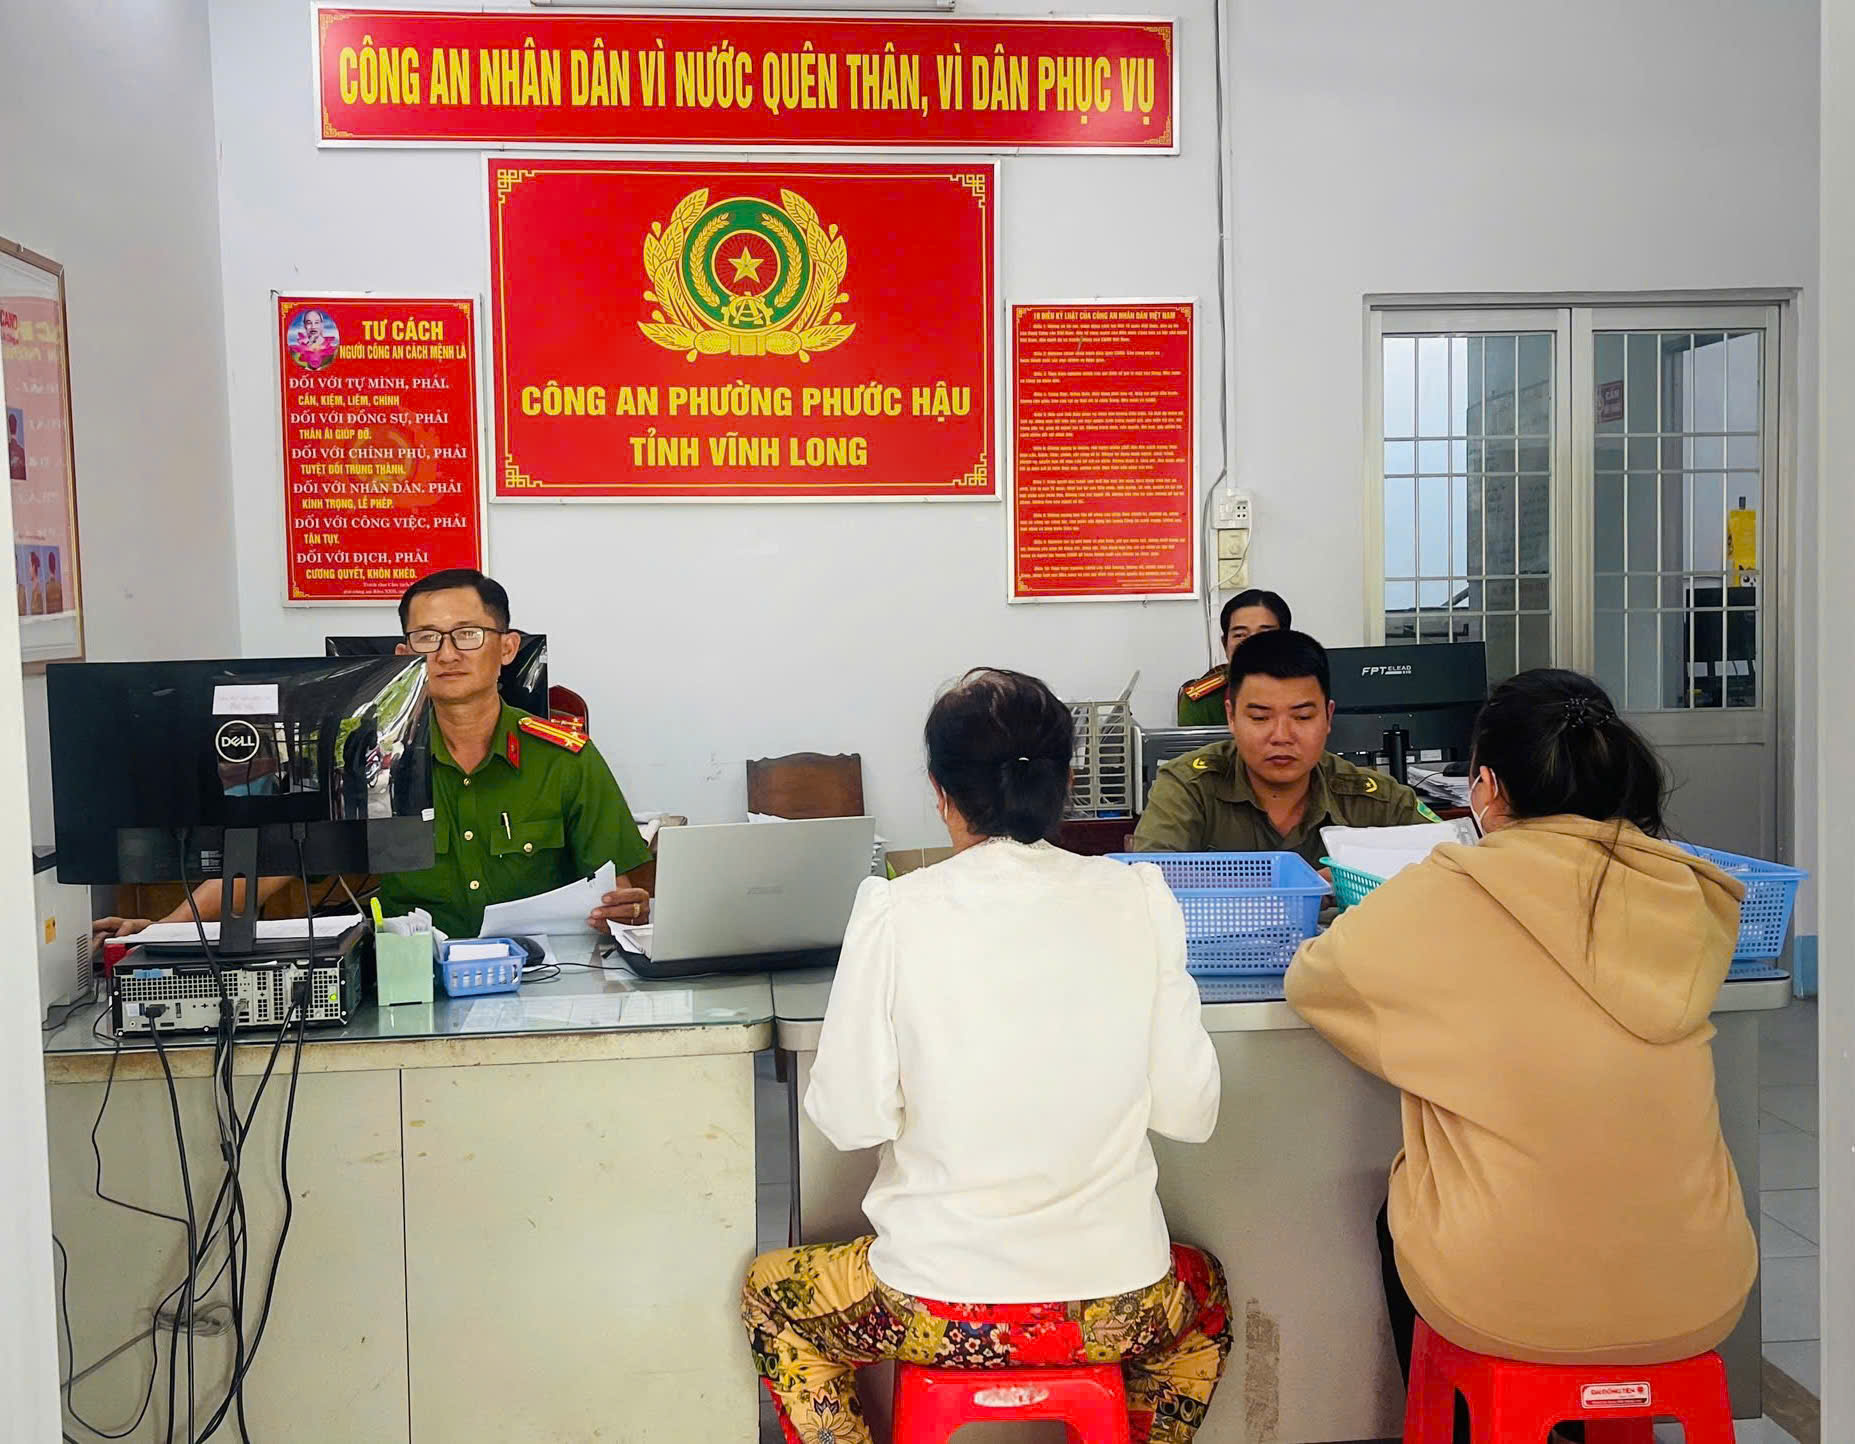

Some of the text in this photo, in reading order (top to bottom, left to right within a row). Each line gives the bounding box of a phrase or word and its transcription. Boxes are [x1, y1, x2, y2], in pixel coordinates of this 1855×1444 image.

[339, 34, 1155, 125] CÔNG AN NHÂN DÂN VÌ NƯỚC QUÊN THÂN, VÌ DÂN PHỤC VỤ
[362, 317, 443, 341] TƯ CÁCH
[367, 343, 389, 359] CÔNG
[392, 346, 403, 359] AN
[407, 343, 428, 359] CÁCH
[430, 343, 454, 362] MỆNH
[456, 343, 466, 359] LÀ
[289, 374, 314, 388] ĐỐI
[318, 375, 342, 388] VỚI
[346, 376, 365, 391] TỰ
[368, 376, 409, 389] MÌNH,
[521, 379, 970, 422] CÔNG AN PHƯỜNG PHƯỚC HẬU
[291, 409, 448, 425] ĐỐI VỚI ĐỒNG SỰ, PHẢI
[292, 444, 467, 460] ĐỐI VỚI CHÍNH PHỦ, PHẢI
[630, 427, 867, 466] TỈNH VĨNH LONG
[345, 464, 373, 474] TRUNG
[293, 480, 318, 494] ĐỐI
[322, 481, 346, 493] VỚI
[350, 481, 388, 493] NHÂN
[428, 479, 462, 493] PHẢI
[295, 514, 467, 530] ĐỐI VỚI CÔNG VIỆC, PHẢI
[297, 549, 428, 565] ĐỐI VỚI ĐỊCH, PHẢI
[1361, 667, 1387, 677] FPT
[221, 735, 255, 748] DELL
